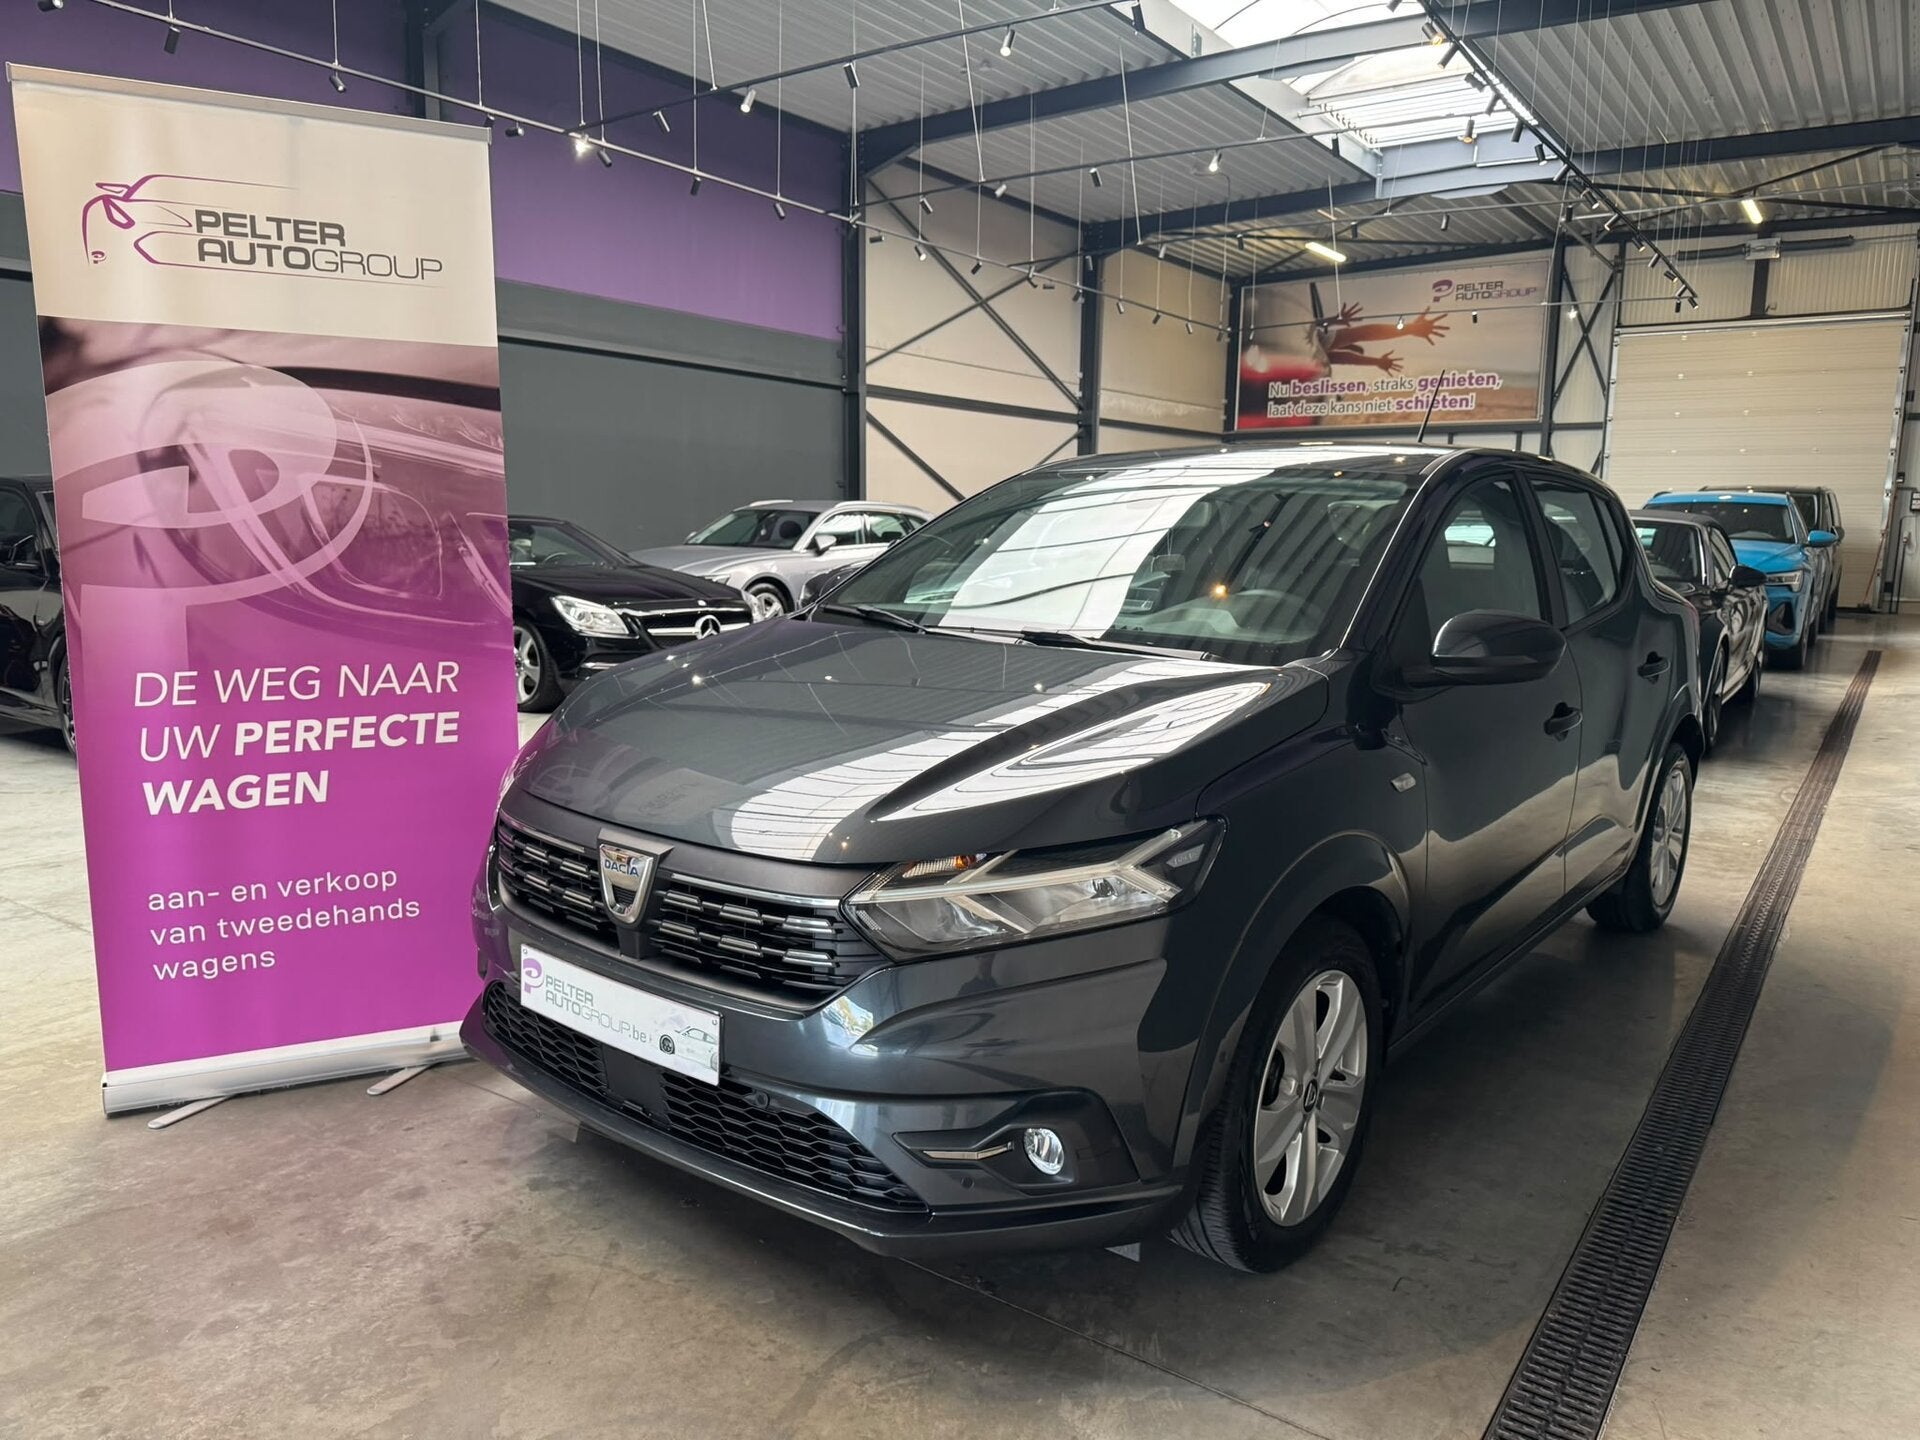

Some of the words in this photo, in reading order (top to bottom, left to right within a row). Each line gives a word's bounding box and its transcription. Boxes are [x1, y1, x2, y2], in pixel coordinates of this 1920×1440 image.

[195, 209, 346, 247] PELTER
[199, 238, 442, 281] AUTOGROUP
[1455, 287, 1537, 302] AUTOGROUP
[1456, 280, 1504, 293] PELTER
[1269, 382, 1288, 397] Nu
[1292, 379, 1370, 396] beslissen,
[1374, 376, 1414, 391] straks
[1418, 372, 1501, 392] genieten,
[1269, 402, 1293, 417] laat
[1296, 401, 1327, 415] deze
[1330, 400, 1361, 414] kans
[1365, 398, 1392, 413] niet
[1395, 394, 1474, 410] schieten!
[134, 671, 198, 707] DE
[213, 665, 321, 703] WEG
[338, 661, 460, 697] NAAR
[140, 724, 221, 762] UW
[234, 711, 460, 756] PERFECTE
[142, 770, 329, 815] WAGEN
[604, 859, 639, 877] DACIA
[148, 890, 220, 911] aan-
[231, 883, 267, 902] en
[277, 870, 397, 898] verkoop
[150, 924, 206, 946] van
[216, 897, 421, 938] tweedehands
[153, 950, 276, 980] wagens
[545, 974, 594, 1007] PELTER
